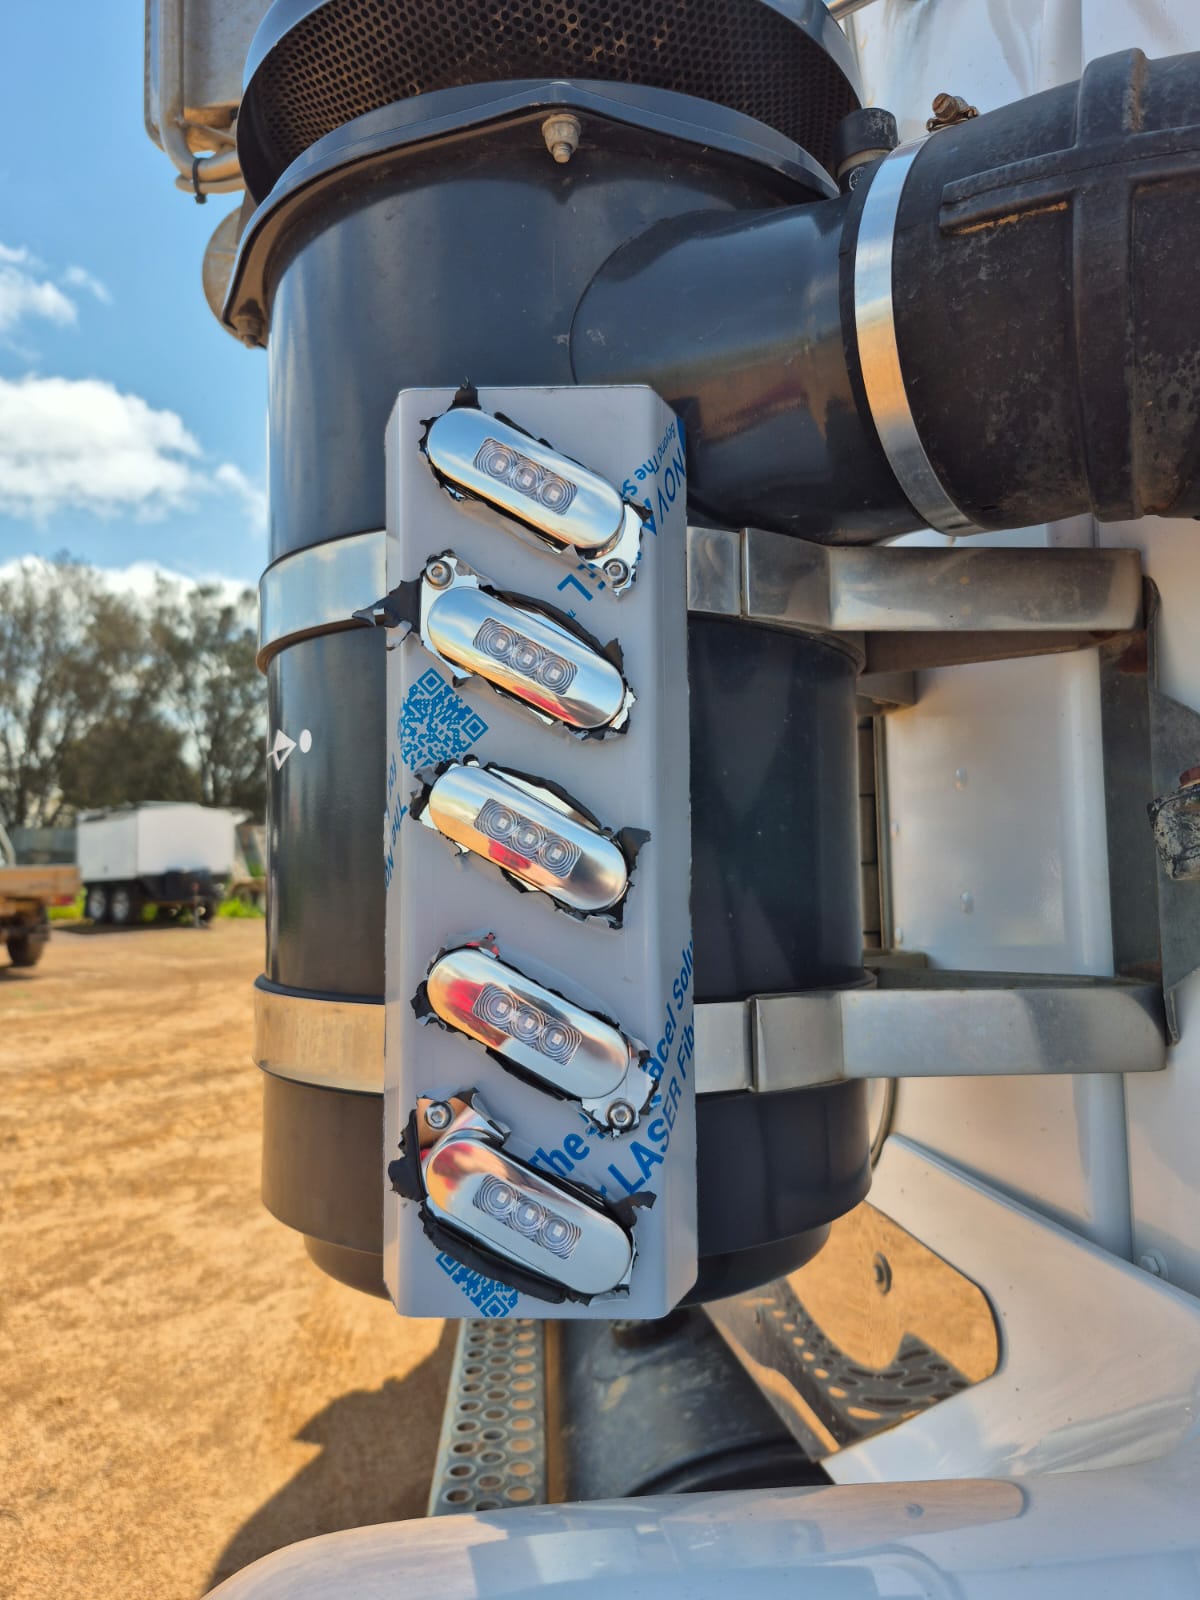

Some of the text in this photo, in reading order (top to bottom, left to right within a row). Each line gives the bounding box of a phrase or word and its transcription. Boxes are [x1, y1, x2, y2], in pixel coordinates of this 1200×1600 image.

[622, 479, 638, 501] S
[634, 455, 660, 481] The
[557, 447, 686, 602] NOVAL
[607, 1075, 682, 1195] LASER
